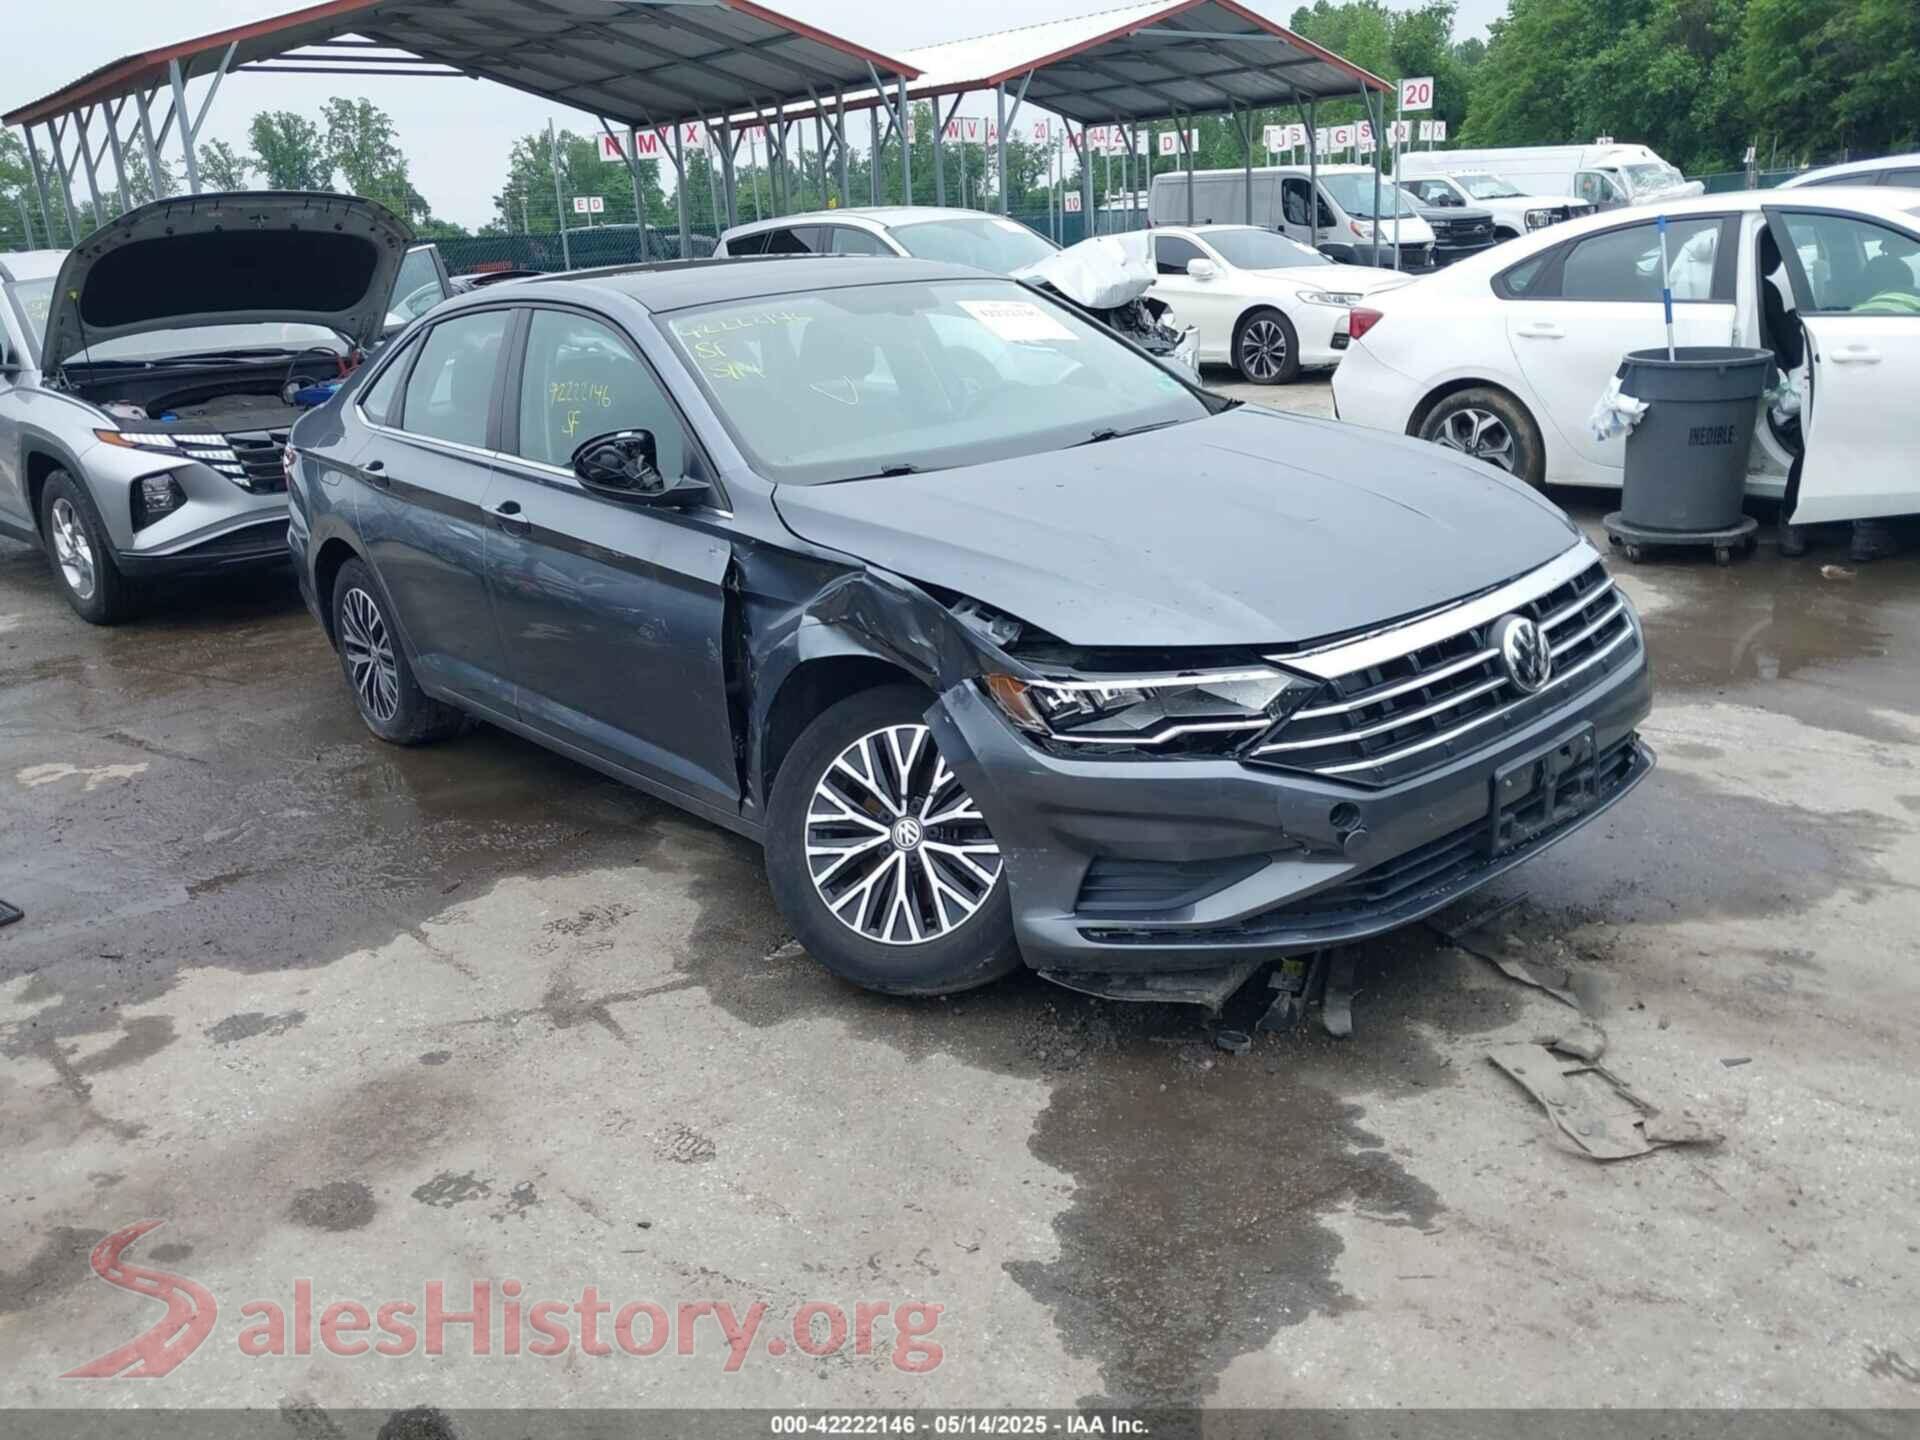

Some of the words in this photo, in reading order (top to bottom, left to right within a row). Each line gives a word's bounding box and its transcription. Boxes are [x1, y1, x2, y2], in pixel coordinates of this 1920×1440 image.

[1406, 83, 1429, 105] 20
[686, 124, 697, 142] X
[967, 122, 977, 138] V
[1034, 122, 1047, 139] 20
[1335, 129, 1347, 144] G
[1361, 124, 1371, 138] S
[1436, 123, 1444, 138] X
[638, 134, 656, 153] M
[1163, 136, 1173, 151] D
[592, 199, 601, 210] D
[1067, 196, 1079, 209] 10
[1688, 425, 1735, 446] INEDIBLE
